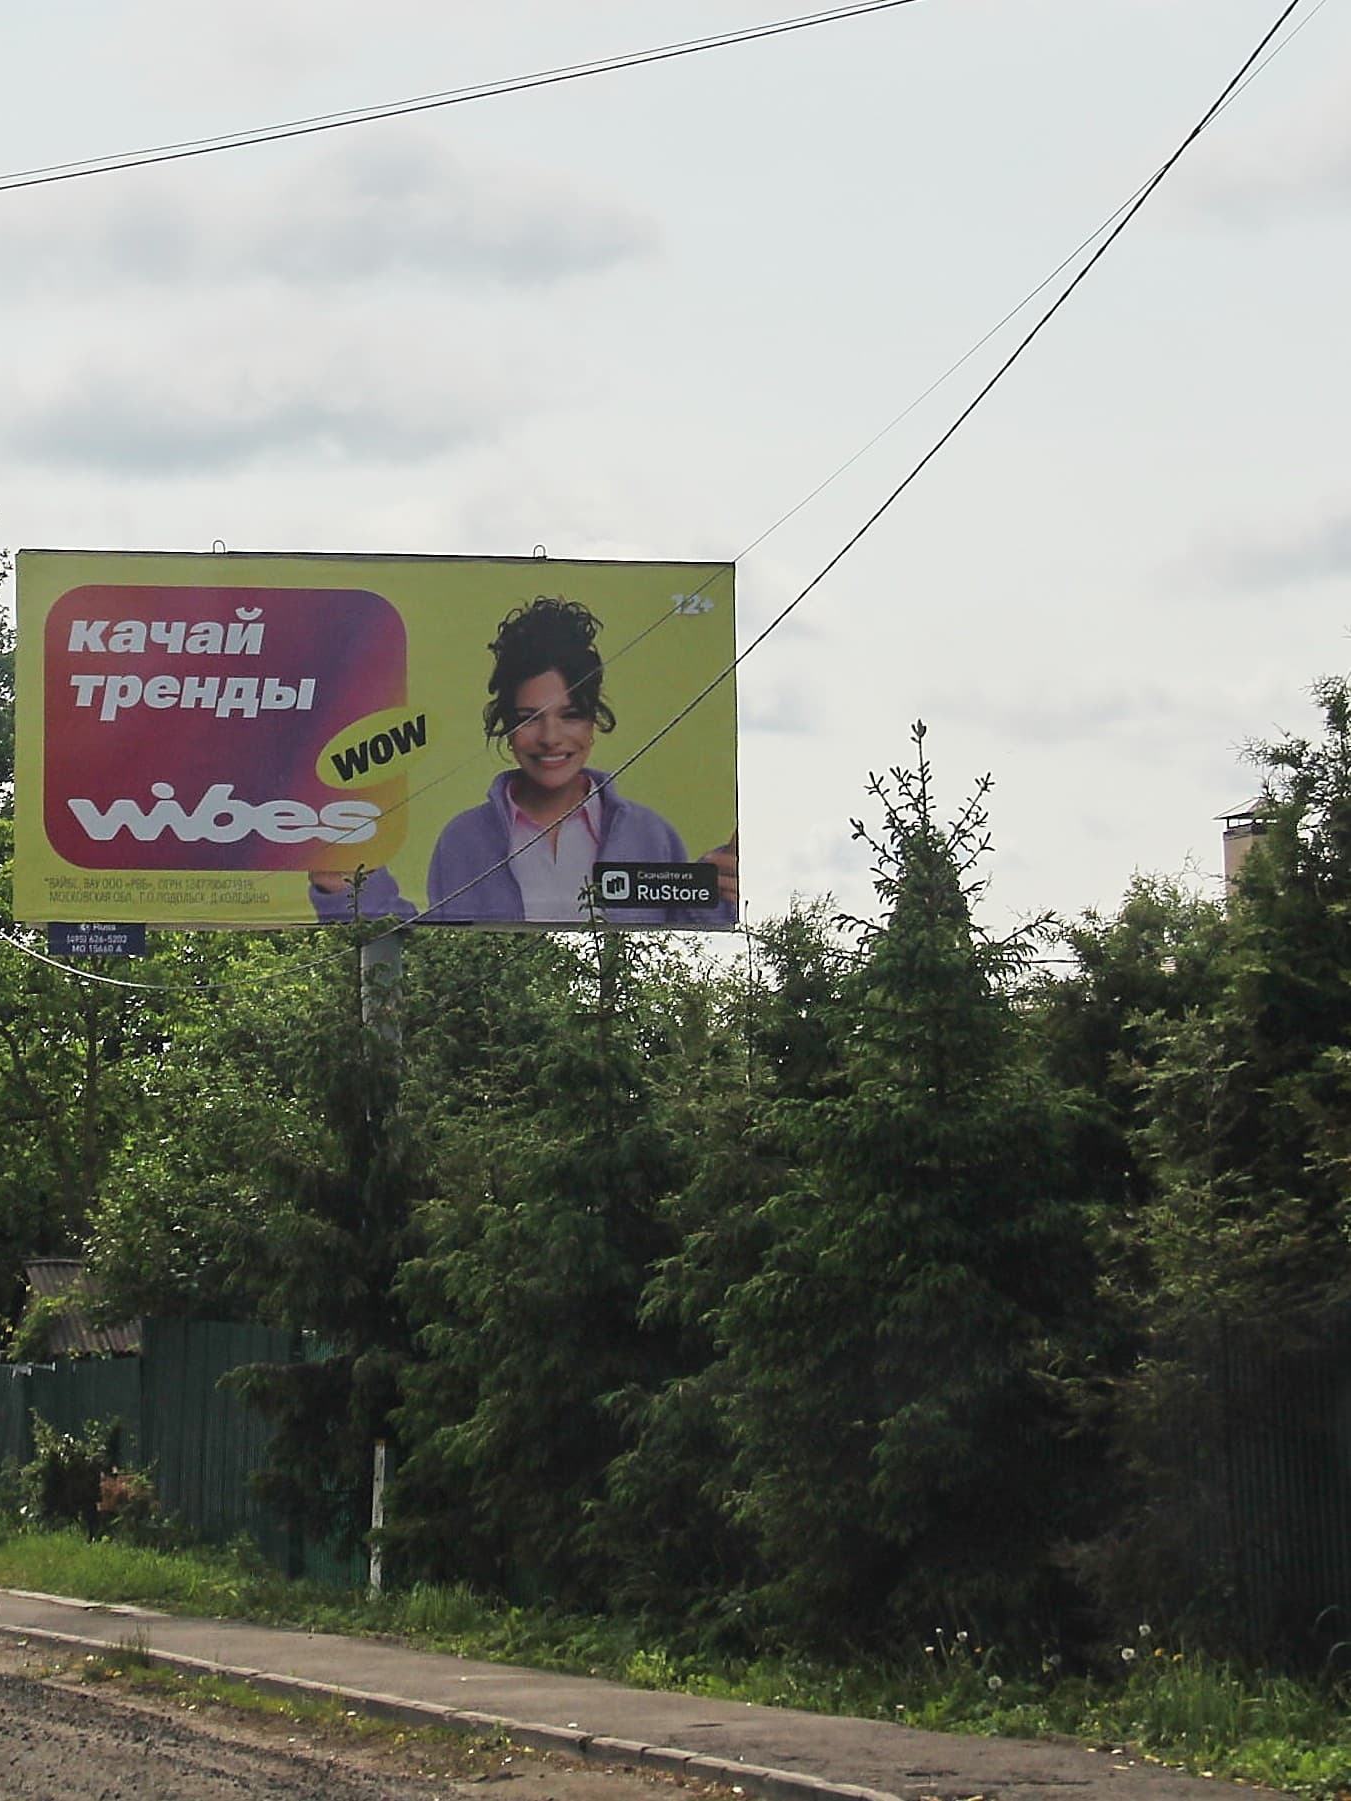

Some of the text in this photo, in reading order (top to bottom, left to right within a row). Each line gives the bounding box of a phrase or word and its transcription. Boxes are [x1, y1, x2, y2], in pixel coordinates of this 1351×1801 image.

[68, 607, 265, 655] качай
[70, 675, 316, 721] тренды
[330, 714, 426, 782] WOW
[68, 782, 382, 844] wibes
[636, 884, 710, 901] RuStore
